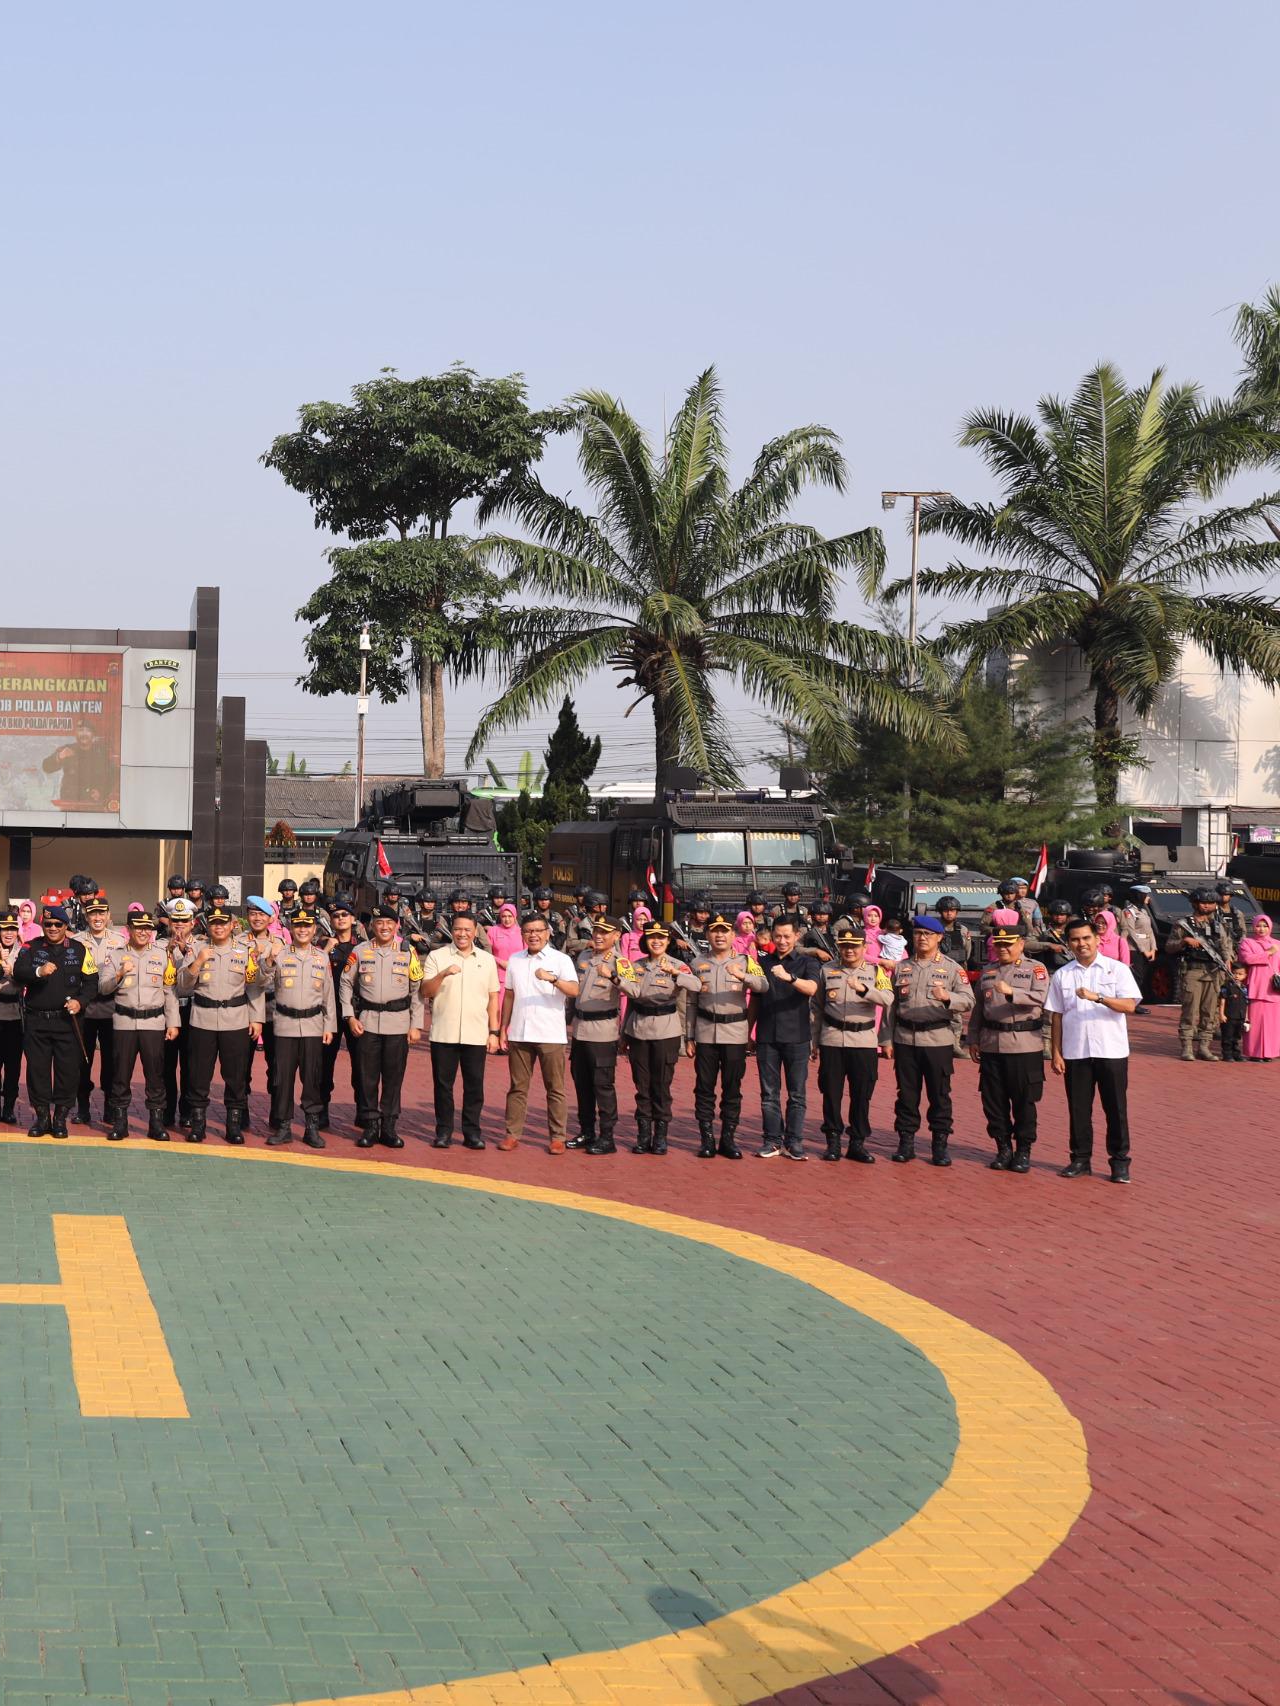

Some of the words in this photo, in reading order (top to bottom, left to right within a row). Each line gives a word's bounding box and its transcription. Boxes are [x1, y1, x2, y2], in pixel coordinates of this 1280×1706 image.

[15, 700, 53, 713] POLDA
[56, 701, 103, 714] BANTEN
[24, 717, 47, 730] POLDA
[48, 718, 73, 730] PAPUA
[696, 832, 743, 841] KORPS
